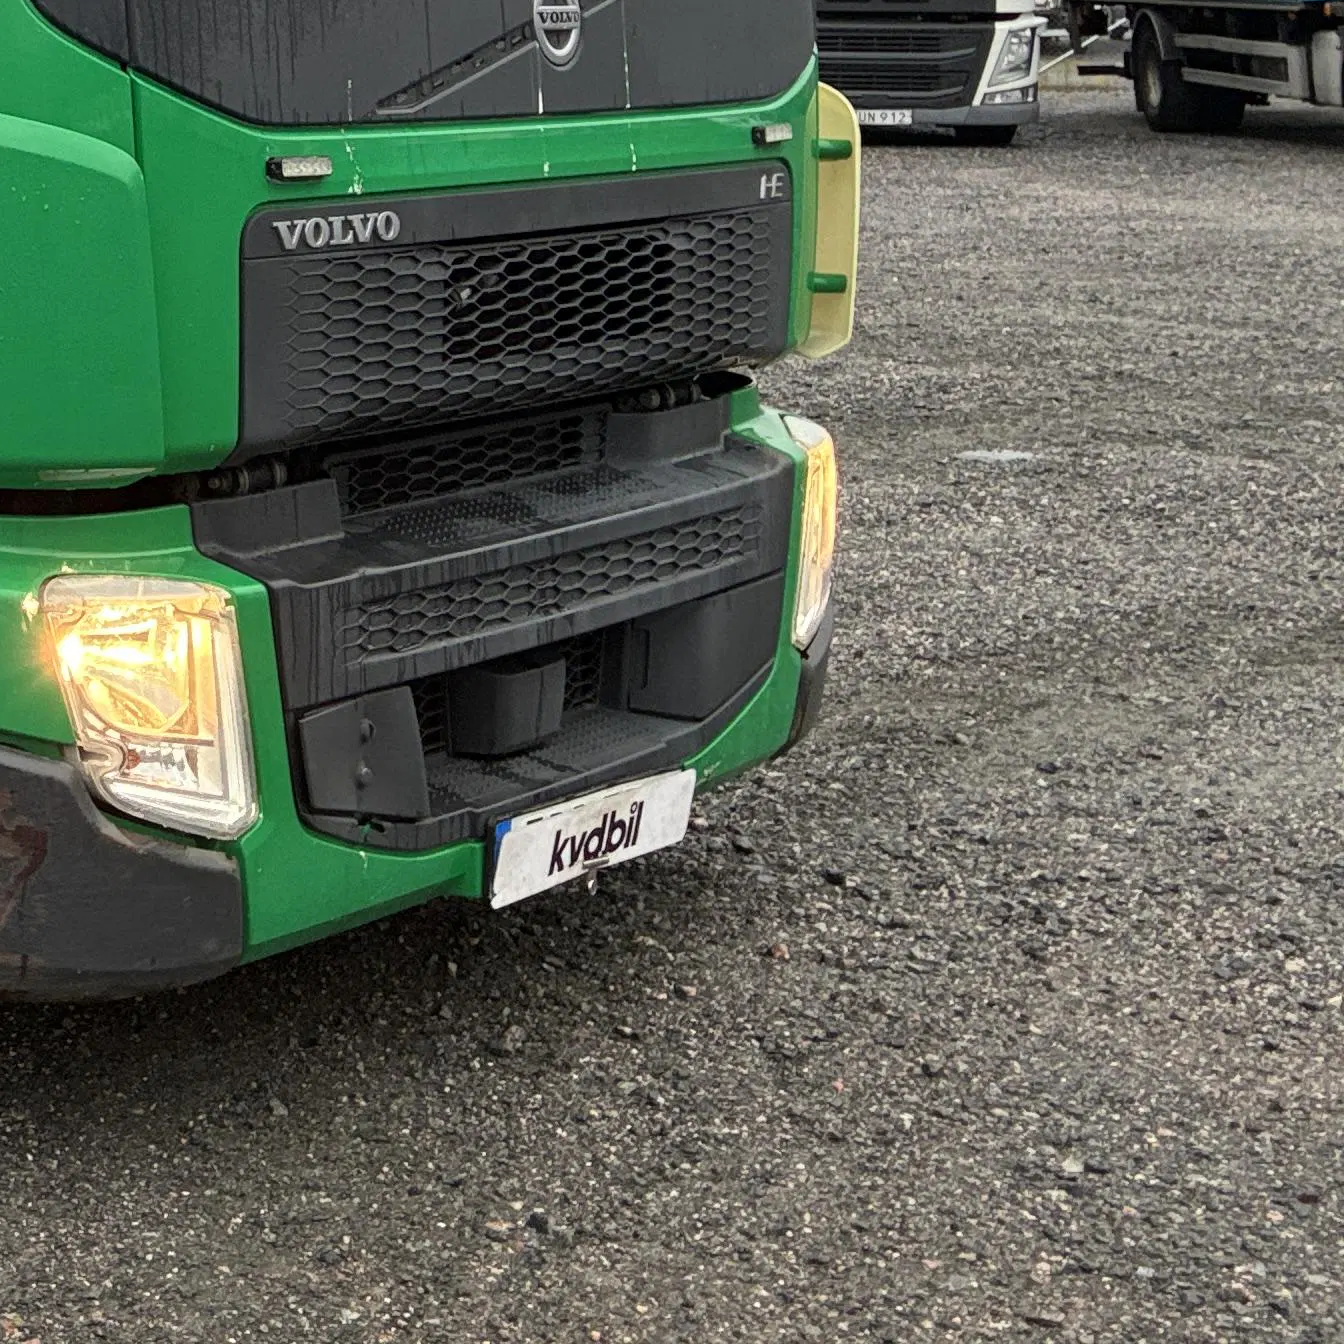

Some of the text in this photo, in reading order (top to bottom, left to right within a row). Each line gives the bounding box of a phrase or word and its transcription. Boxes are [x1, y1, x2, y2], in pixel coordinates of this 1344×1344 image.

[537, 11, 579, 24] VOLVO
[859, 112, 906, 123] UN 912
[272, 211, 401, 250] VOLVO
[548, 801, 644, 876] kvdbil
